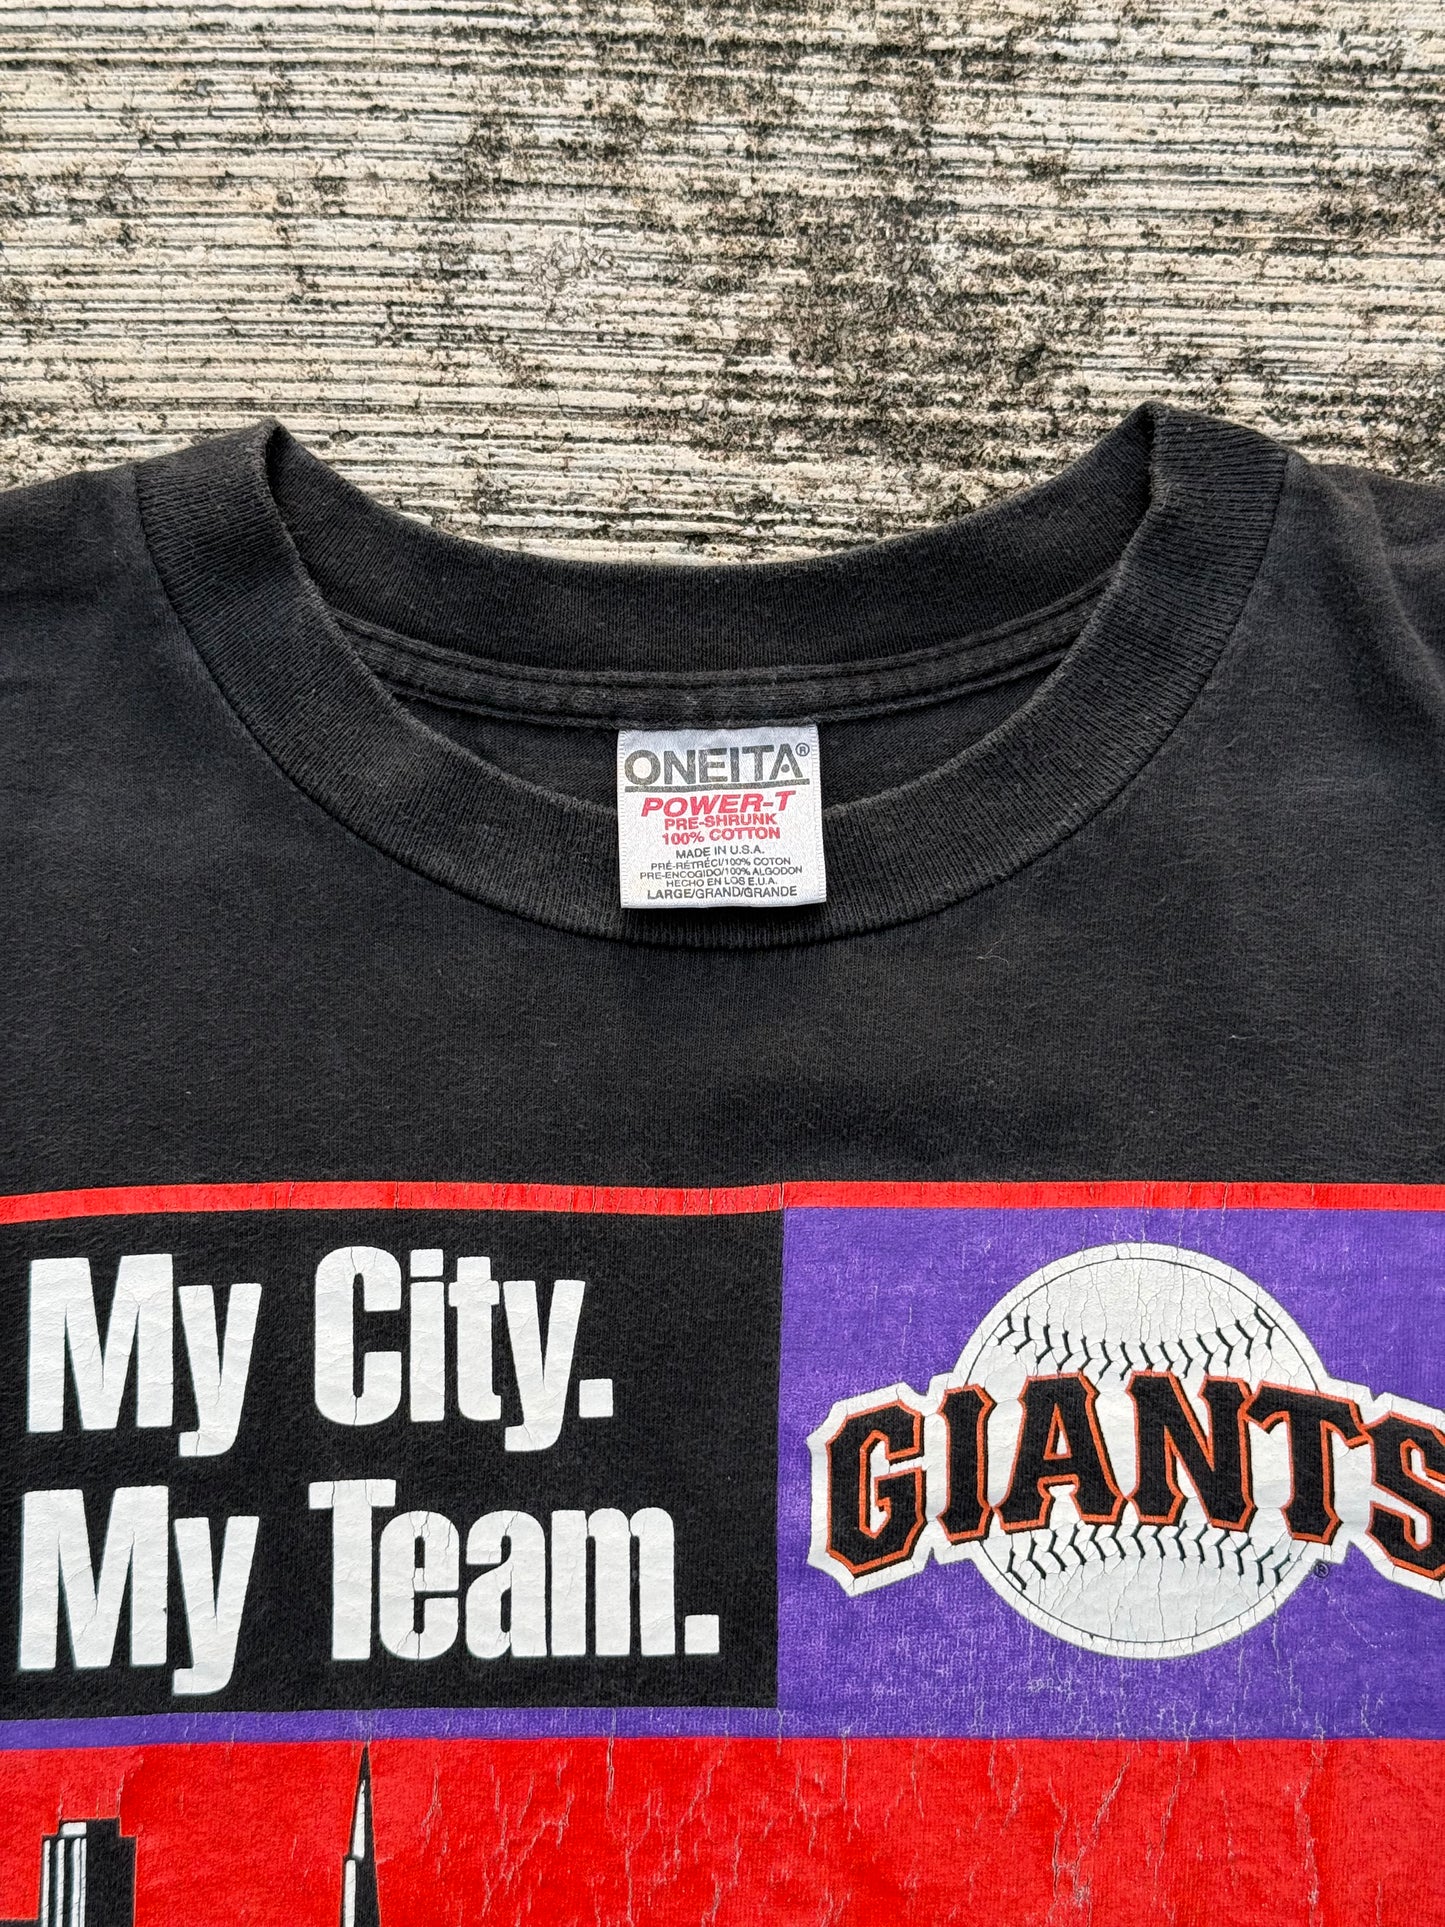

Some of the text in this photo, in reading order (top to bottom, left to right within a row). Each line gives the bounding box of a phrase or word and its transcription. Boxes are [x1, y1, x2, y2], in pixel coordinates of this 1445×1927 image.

[641, 790, 797, 818] POWER-T
[664, 813, 778, 831] PRE-SHRUNK
[662, 827, 781, 846] 100% COTTON
[675, 845, 765, 860] MADE IN U.S.A.
[753, 857, 791, 866] COTON
[752, 866, 803, 876] ALGODON
[666, 875, 778, 888] HECHO EN LOS E.U.A.
[647, 886, 798, 900] LARGE/GRAND/GRANDE
[27, 1246, 614, 1457] My City.
[826, 1369, 1445, 1581] GIANTS
[18, 1478, 720, 1696] My Team.
